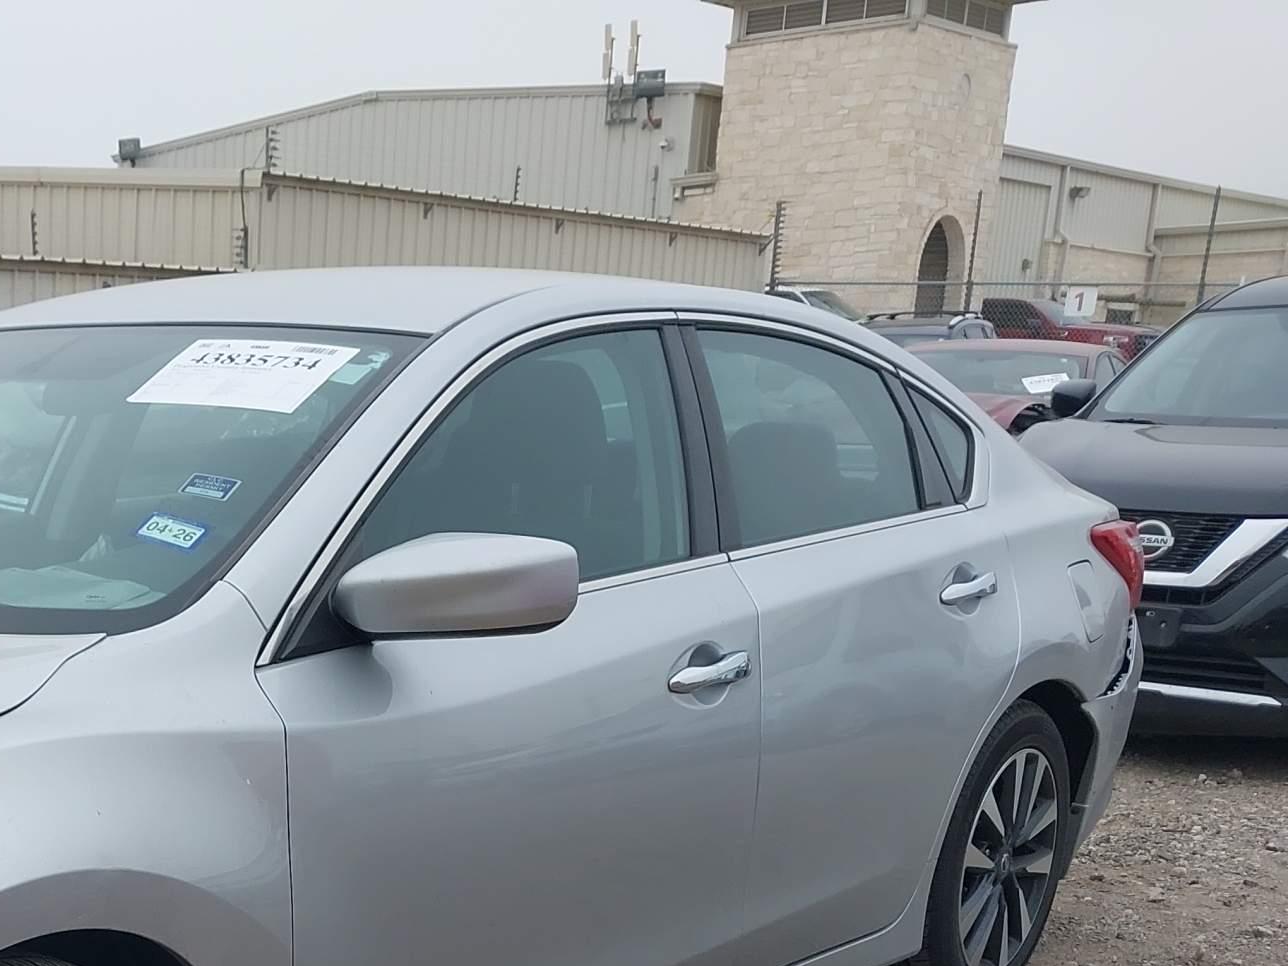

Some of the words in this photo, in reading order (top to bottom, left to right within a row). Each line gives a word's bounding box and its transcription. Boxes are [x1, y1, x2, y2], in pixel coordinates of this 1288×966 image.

[1075, 292, 1085, 311] 1
[190, 351, 322, 371] 43835734
[1139, 536, 1169, 545] SSAN
